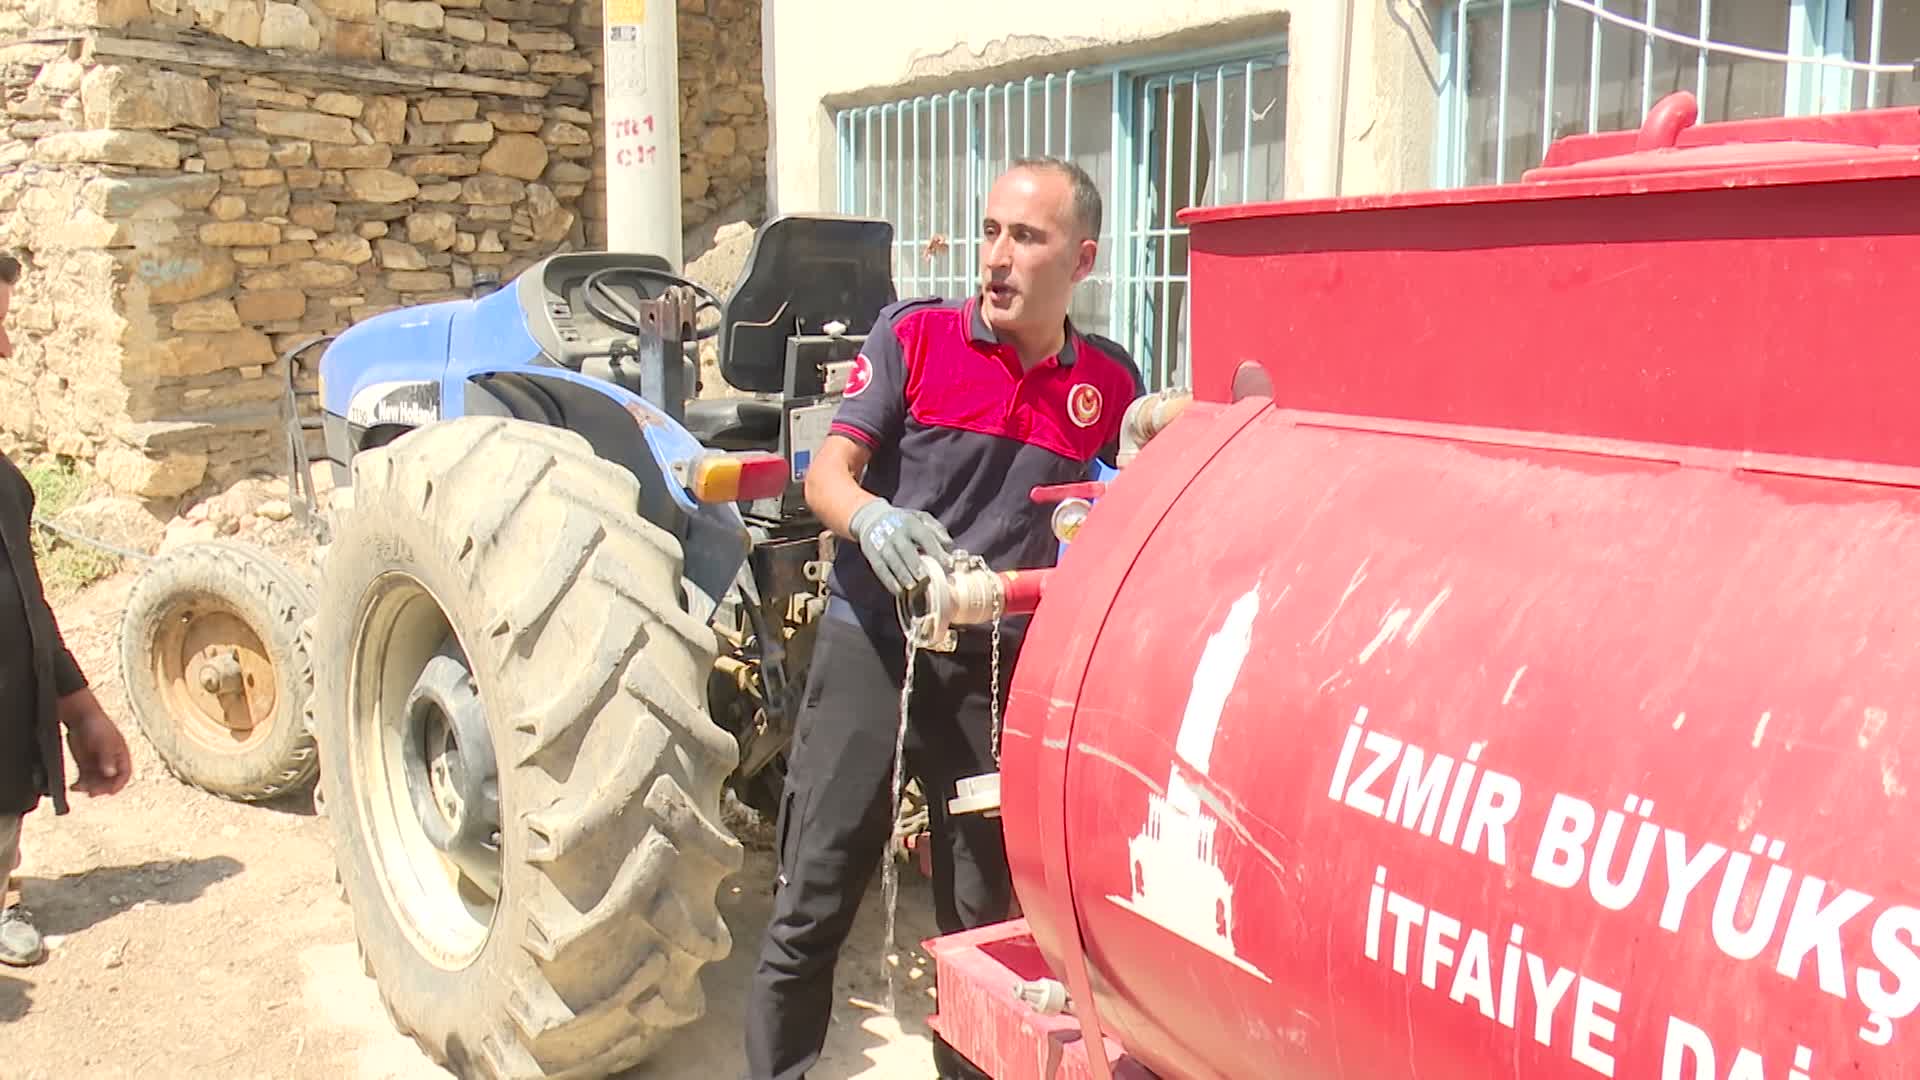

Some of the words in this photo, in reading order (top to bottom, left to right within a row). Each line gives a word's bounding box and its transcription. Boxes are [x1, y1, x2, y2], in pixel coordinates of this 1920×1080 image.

[379, 400, 399, 421] New
[400, 400, 437, 423] Holland
[1328, 706, 1522, 865] İZMİR
[1531, 794, 1920, 1046] BÜYÜKŞ
[1364, 865, 1622, 1077] İTFAİYE
